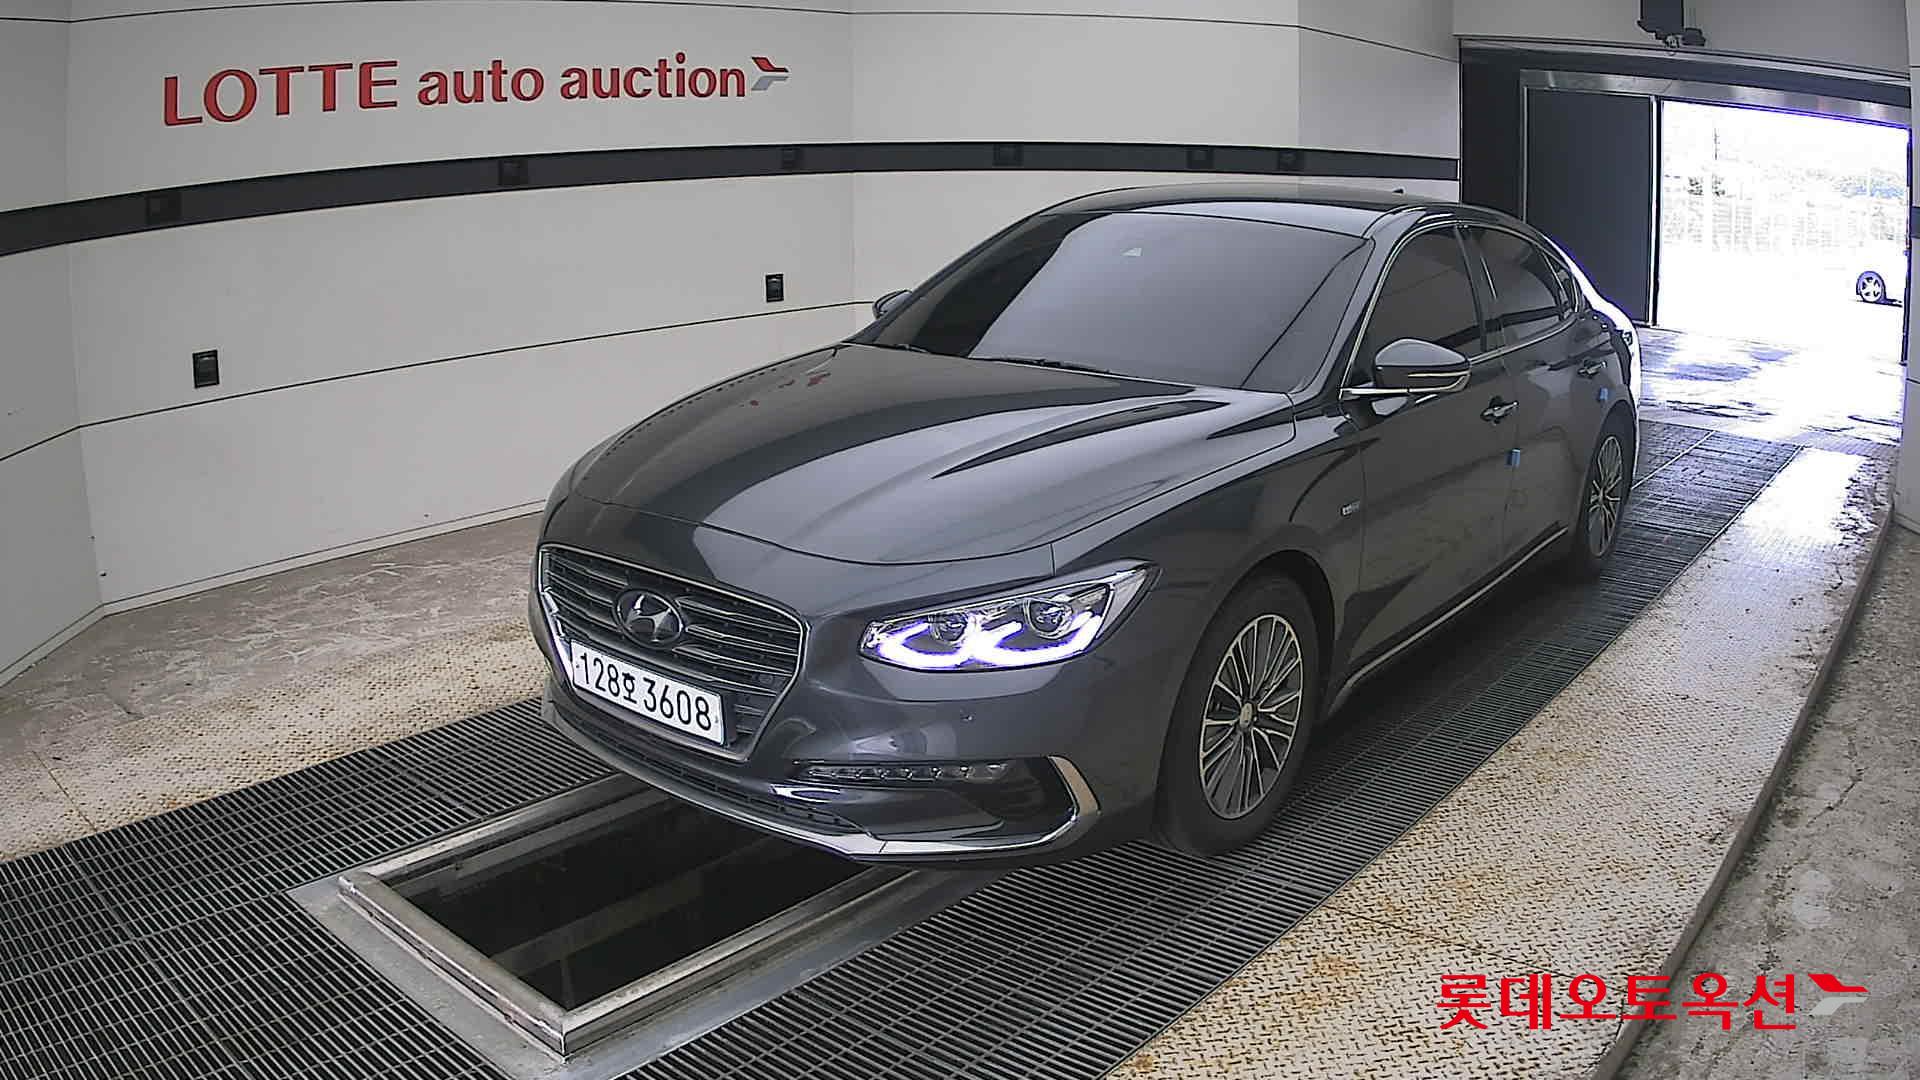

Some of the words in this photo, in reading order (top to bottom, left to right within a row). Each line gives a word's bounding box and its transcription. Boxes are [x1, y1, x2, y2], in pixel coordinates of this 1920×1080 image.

[163, 60, 399, 126] LOTTE
[417, 57, 545, 106] auto
[560, 52, 747, 101] auction
